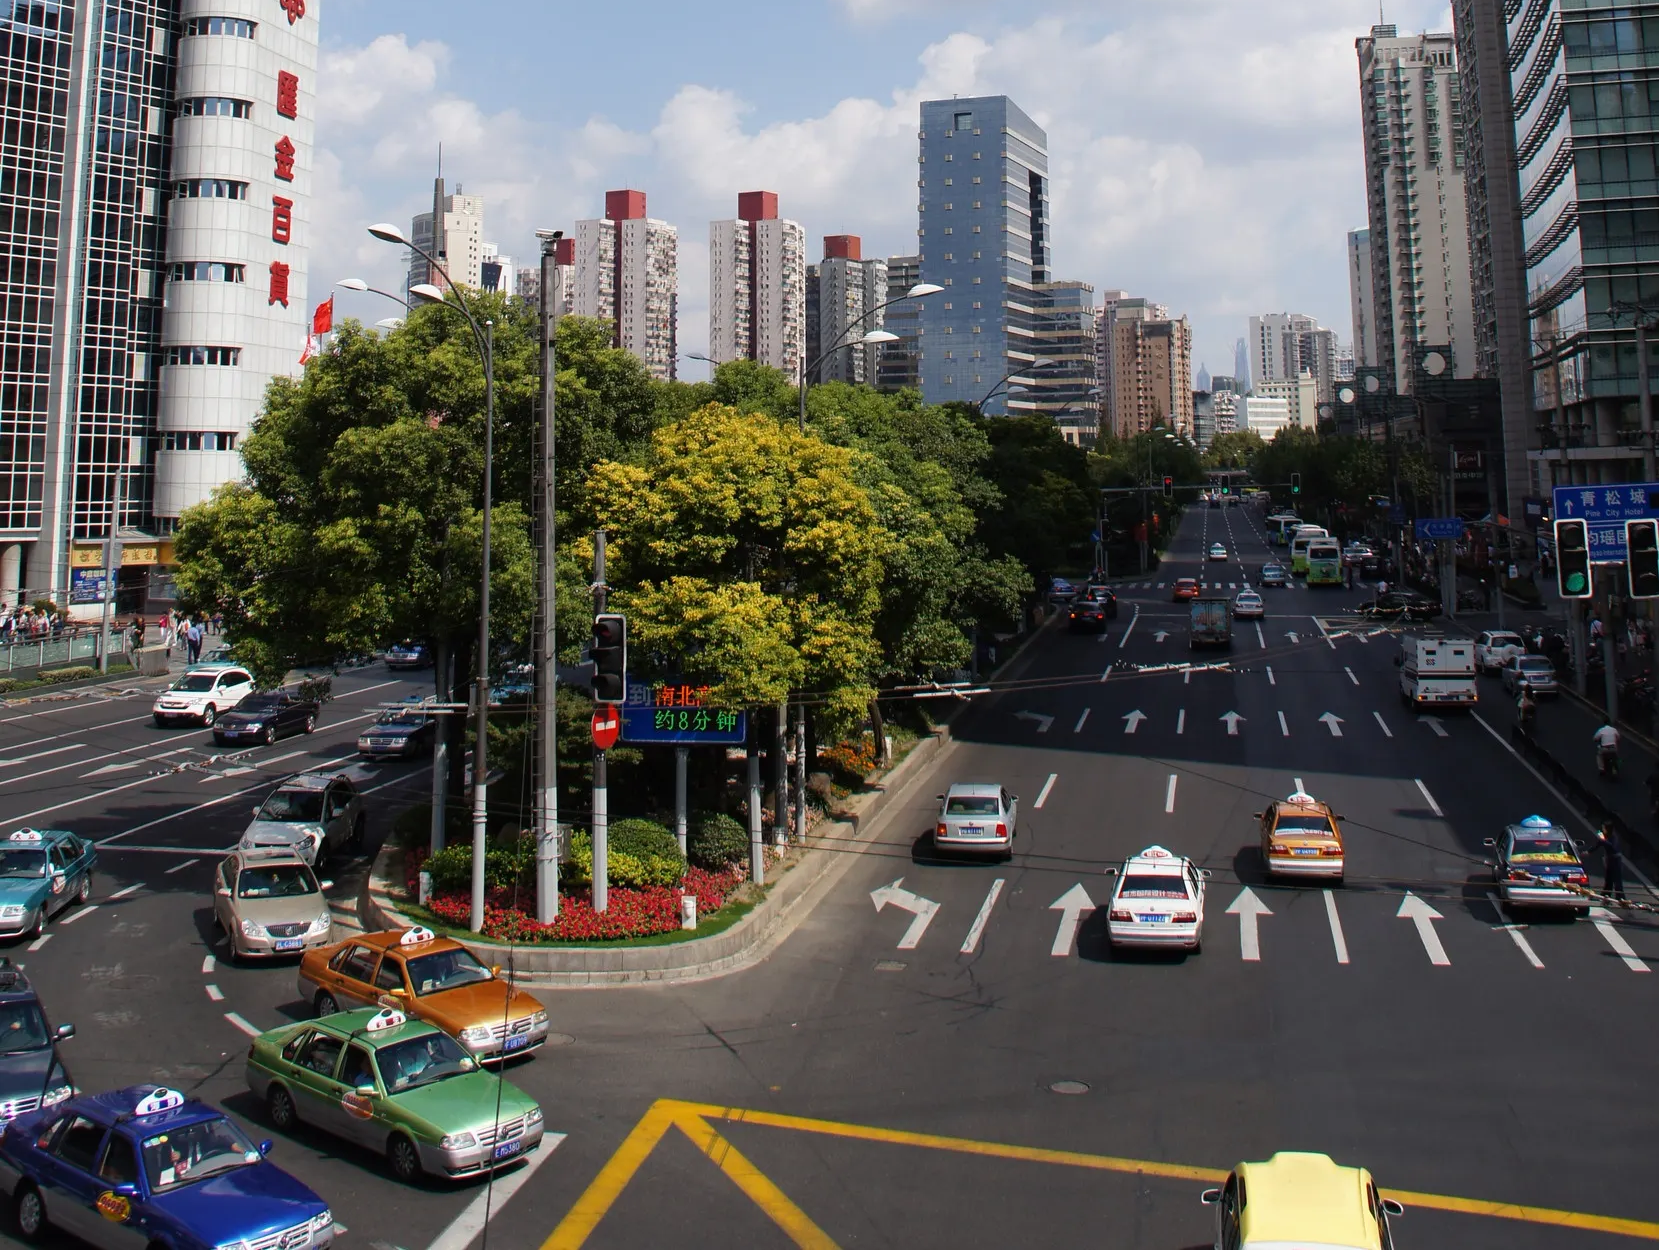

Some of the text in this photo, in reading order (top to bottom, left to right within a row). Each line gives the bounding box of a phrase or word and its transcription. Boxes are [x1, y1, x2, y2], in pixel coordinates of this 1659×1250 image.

[268, 69, 299, 309] 匯金百貨
[1580, 488, 1647, 507] 青松城
[1605, 509, 1620, 517] City
[1624, 508, 1644, 516] Hotel
[655, 709, 736, 733] 约8分钟
